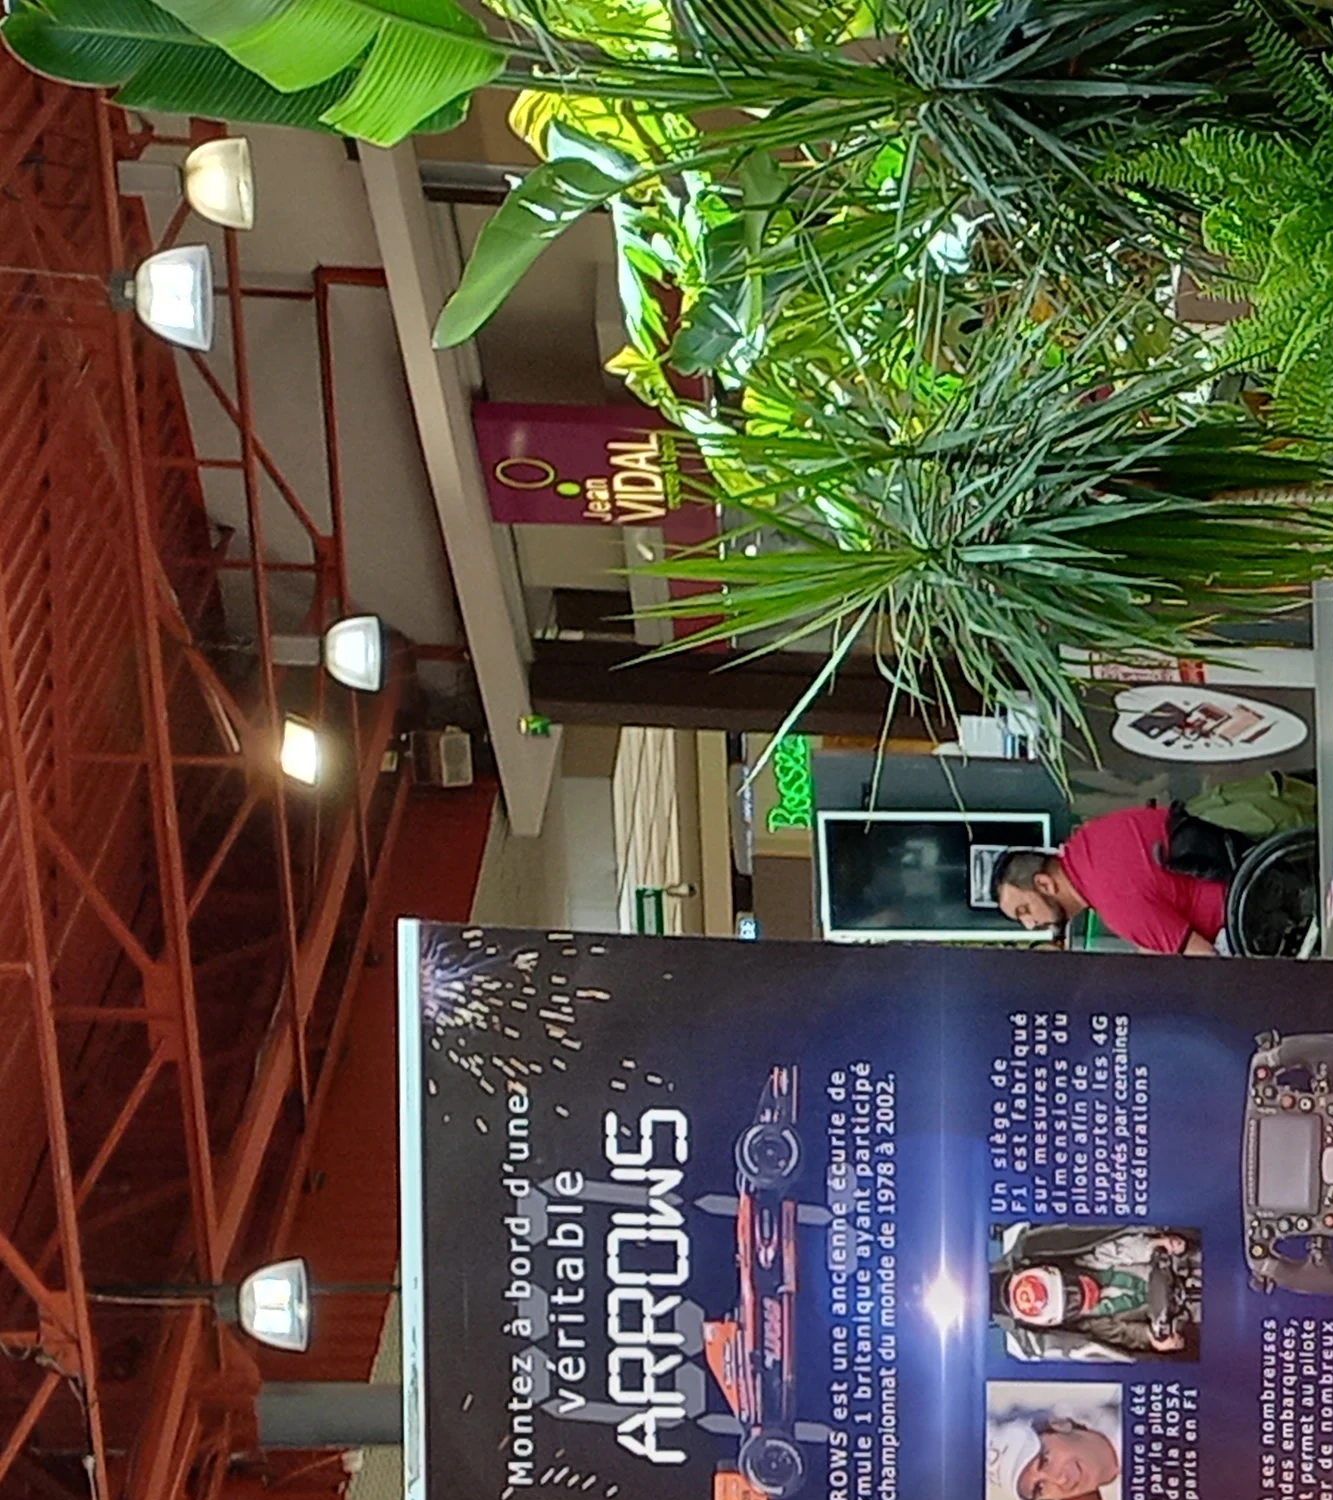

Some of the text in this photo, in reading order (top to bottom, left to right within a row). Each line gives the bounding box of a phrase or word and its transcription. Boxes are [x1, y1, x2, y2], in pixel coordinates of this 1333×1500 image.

[583, 479, 612, 521] Jean
[607, 432, 666, 522] VIDAL
[828, 1071, 846, 1100] de
[877, 1074, 895, 1135] 2002.
[1010, 1013, 1029, 1211] F1 est fabriqué
[1034, 1014, 1047, 1213] sur mesures aux
[1052, 1014, 1067, 1213] dimensions du
[851, 1063, 876, 1177] participé
[989, 1059, 1009, 1212] Un siège de
[1072, 1065, 1089, 1214] pilote afin de
[1092, 1016, 1109, 1214] supporter les 4G
[1111, 1016, 1130, 1214] générés par certaines
[828, 1113, 847, 1191] écurie
[876, 1143, 894, 1155] à
[877, 1163, 894, 1214] 1978
[854, 1188, 877, 1258] ayant
[877, 1224, 895, 1248] de
[606, 1109, 689, 1463] ARROWS
[829, 1204, 848, 1315] ancienne
[503, 1095, 534, 1485] Montez à bord d'une
[546, 1170, 586, 1413] véritable
[877, 1257, 895, 1327] monde
[833, 1327, 848, 1369] une
[853, 1270, 877, 1399] britanique
[877, 1334, 896, 1360] du
[1299, 1320, 1317, 1376] pilote
[830, 1383, 848, 1419] est
[1131, 1384, 1145, 1415] été
[1184, 1390, 1197, 1409] F1
[1260, 1319, 1276, 1445] nombreuses
[1280, 1319, 1298, 1450] embarquées,
[1302, 1384, 1314, 1407] au
[1320, 1321, 1333, 1432] nombreux
[855, 1413, 872, 1424] 1
[1135, 1425, 1145, 1435] a
[1149, 1384, 1164, 1434] pilote
[1167, 1383, 1180, 1437] ROSA
[1185, 1420, 1196, 1441] en
[1149, 1442, 1162, 1457] le
[1165, 1448, 1179, 1466] la
[1262, 1454, 1274, 1488] ses
[1300, 1415, 1316, 1484] permet
[1319, 1445, 1332, 1469] de
[1151, 1465, 1165, 1493] par
[1166, 1477, 1179, 1500] de
